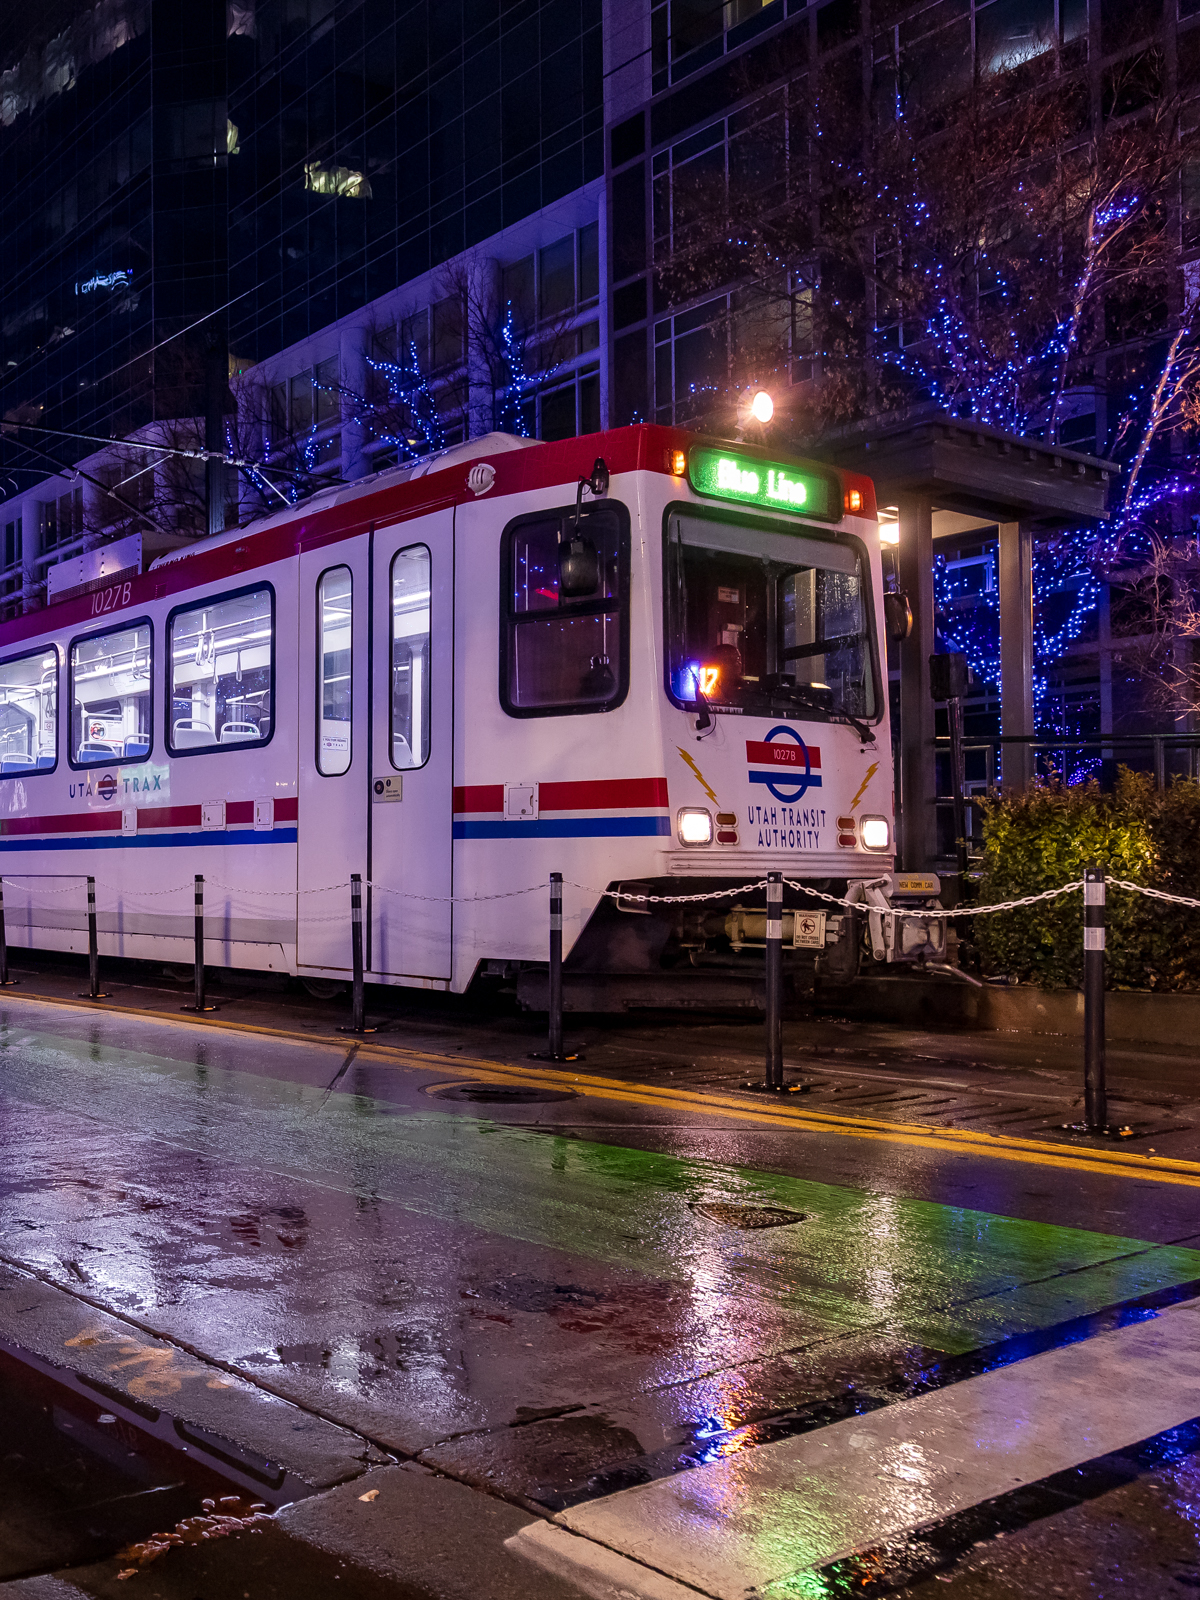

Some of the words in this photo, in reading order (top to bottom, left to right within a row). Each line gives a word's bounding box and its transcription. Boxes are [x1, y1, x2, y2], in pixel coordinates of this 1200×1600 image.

[718, 459, 760, 495] Blue
[767, 469, 807, 504] Line
[91, 581, 132, 615] 1027B
[773, 748, 796, 761] 1027B
[69, 782, 93, 799] UTA
[123, 775, 162, 794] TRAX
[748, 806, 777, 825] UTAH
[781, 807, 826, 828] TRANSIT
[758, 828, 820, 849] AUTHORITY
[899, 881, 909, 889] NEW
[925, 881, 934, 889] CAR
